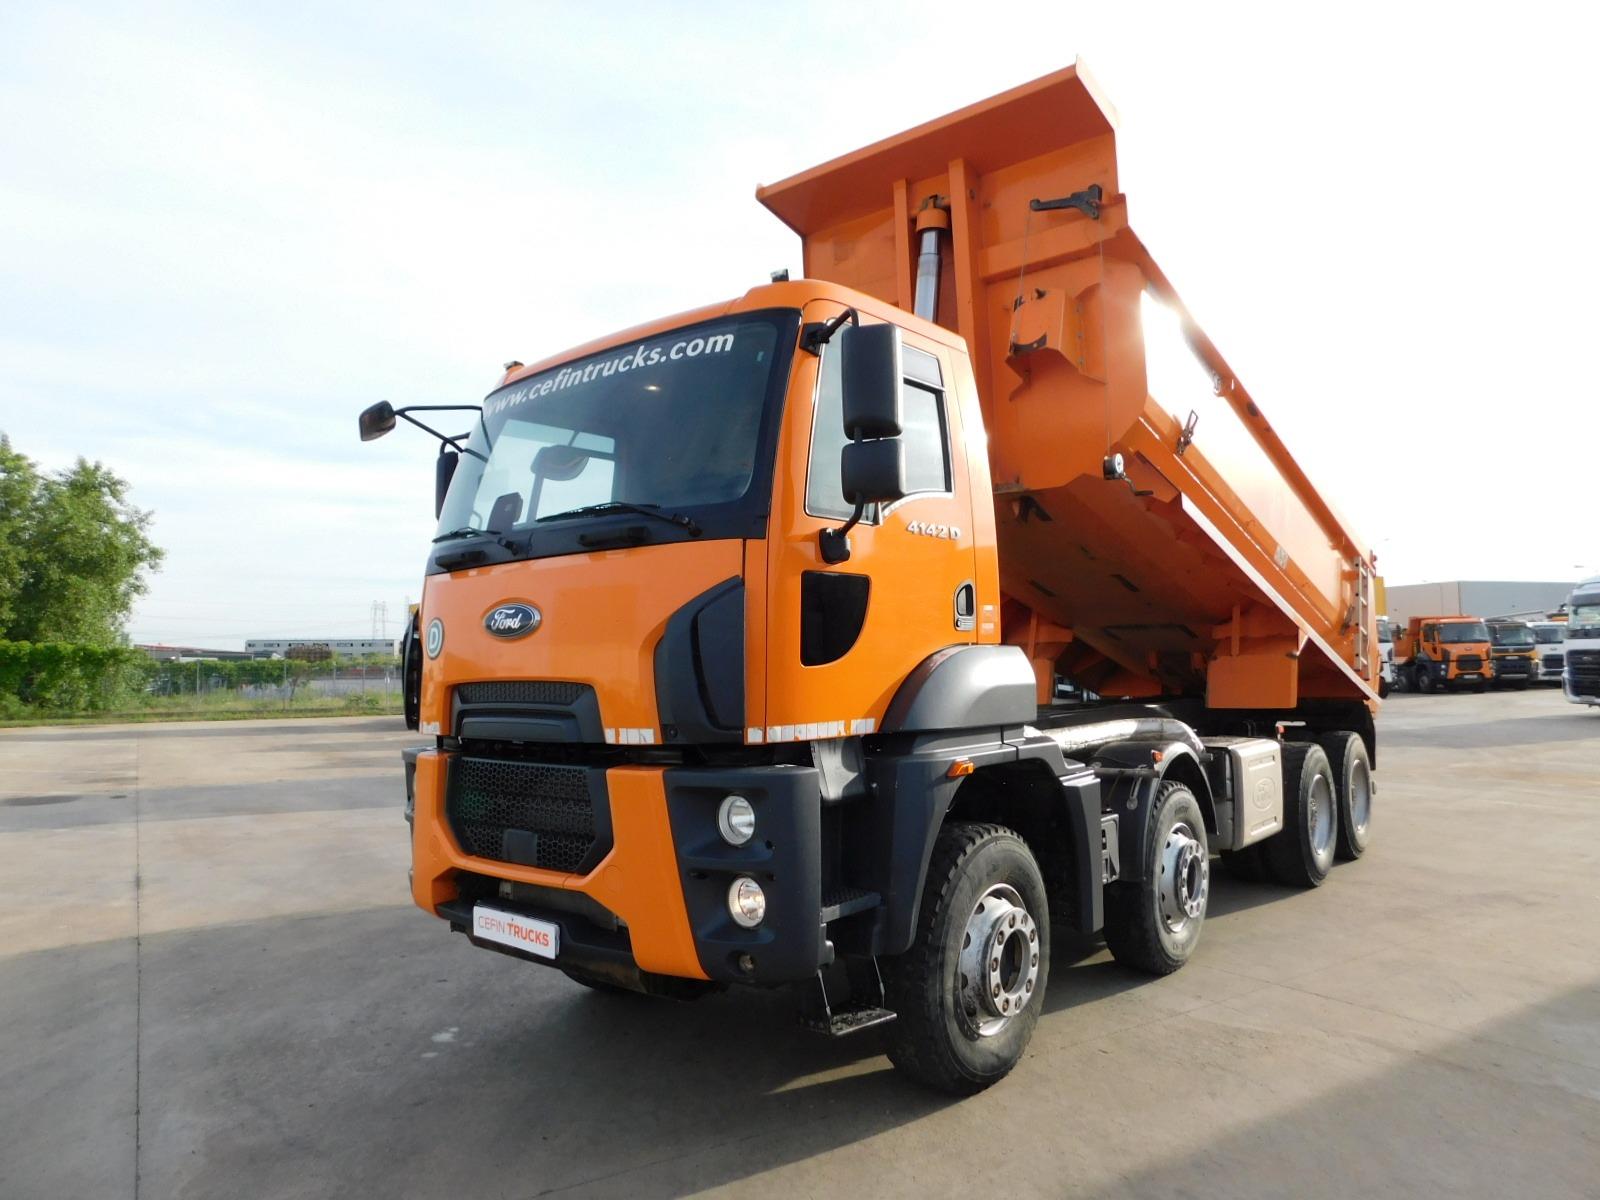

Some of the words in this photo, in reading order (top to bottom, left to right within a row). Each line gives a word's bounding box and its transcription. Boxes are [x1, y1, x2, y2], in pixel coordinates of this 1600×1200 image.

[484, 333, 735, 418] www.cefintrucks.com
[491, 609, 522, 630] Ford
[429, 627, 439, 649] D
[478, 915, 505, 934] CEFIN
[506, 922, 549, 947] TRUCKS
